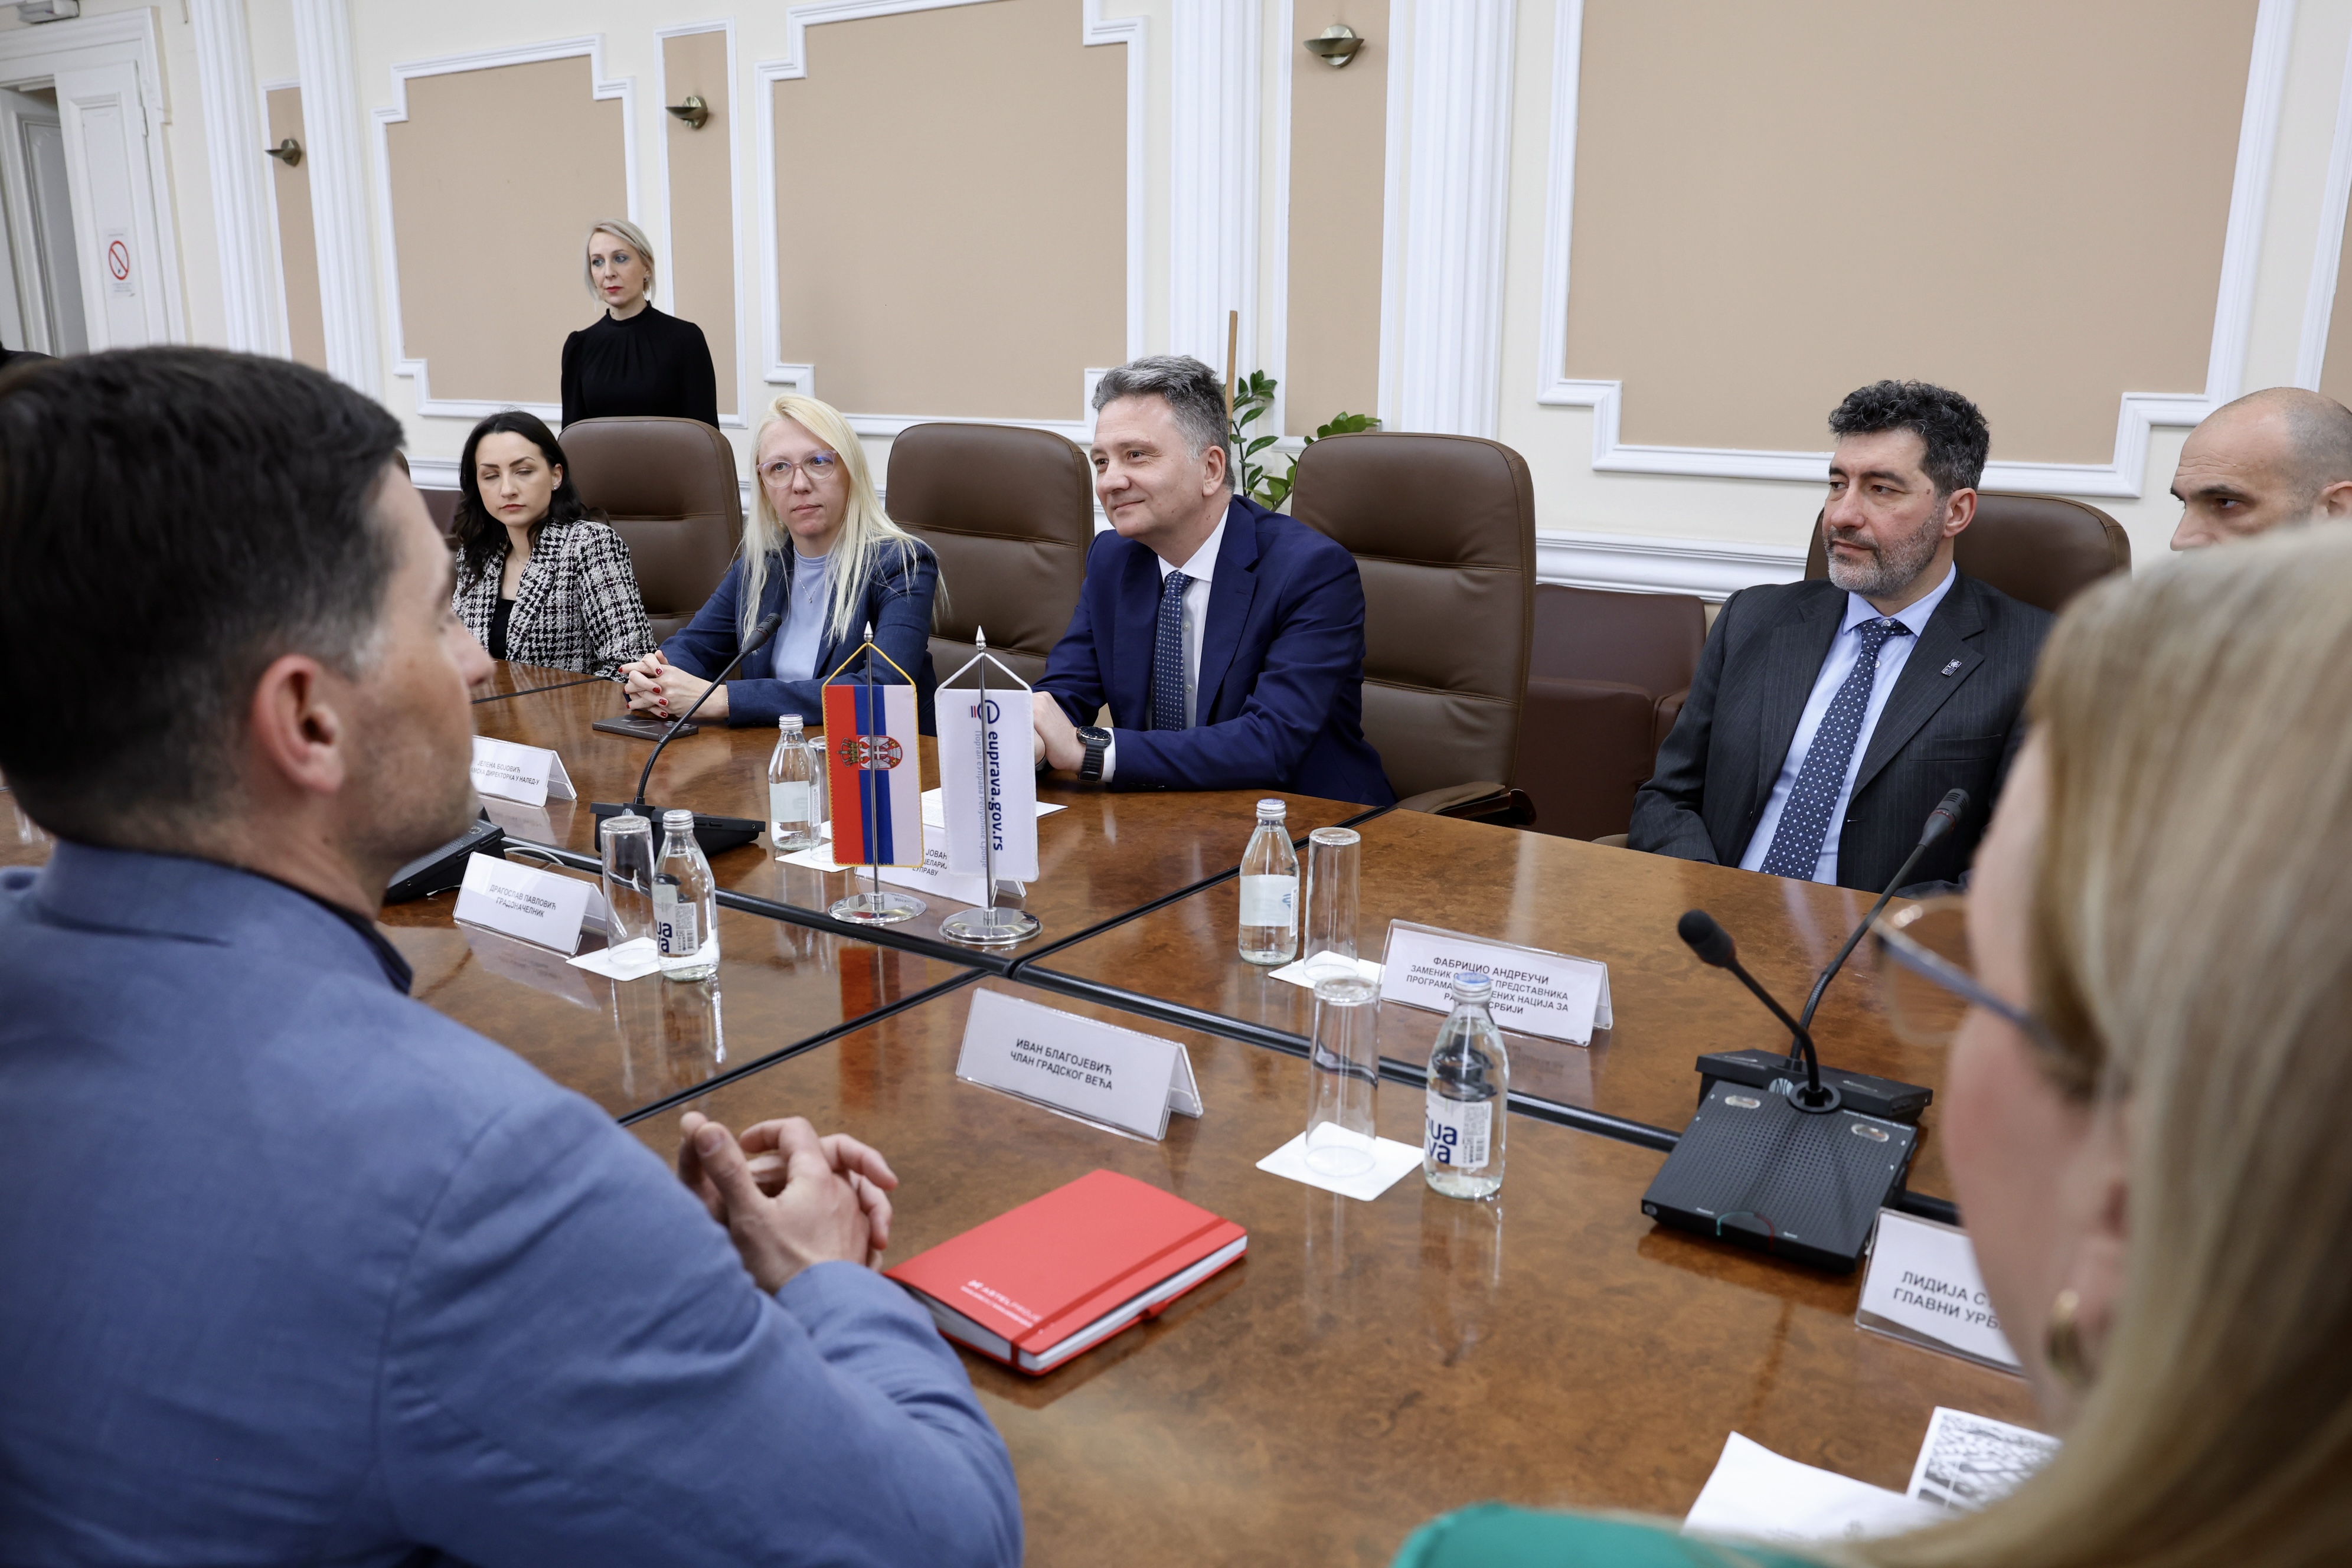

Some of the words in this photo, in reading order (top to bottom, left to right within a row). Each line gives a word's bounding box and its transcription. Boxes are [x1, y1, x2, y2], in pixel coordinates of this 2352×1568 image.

[974, 730, 982, 759] Портал
[471, 767, 485, 775] АМСКА
[485, 770, 515, 780] ДИРЕКТОРКА
[519, 776, 540, 785] НАЛЕД-У
[477, 760, 496, 769] ЈЕЛЕНА
[496, 763, 521, 773] БОЈОВИЋ
[986, 731, 1003, 851] euprava.gov.rs
[925, 848, 947, 860] ЈОВАН
[489, 884, 524, 900] ДРАГОСЛАВ
[524, 894, 556, 910] ПАВЛОВИЋ
[496, 897, 545, 917] ГРАДОНАЧЕЛНИК
[655, 919, 672, 938] ua
[1410, 965, 1452, 979] ЗАМЕНИК
[1495, 980, 1568, 1001] ПРЕДСТАВНИКА
[1433, 956, 1490, 974] ФАБРИЦИО
[1492, 967, 1549, 985] АНДРЕУЧИ
[1406, 975, 1453, 990] ПРОГРАМА
[1491, 990, 1516, 1002] ЕНИХ
[1517, 995, 1554, 1010] НАЦИЈА
[1556, 1002, 1569, 1012] ЗА
[1488, 1001, 1524, 1014] СРБИЈИ
[1010, 1050, 1035, 1066] ЧЛАН
[1036, 1059, 1084, 1080] ГРАДСКОГ
[1085, 1074, 1112, 1090] ВЕЋА
[1016, 1038, 1043, 1054] ИВАН
[1045, 1047, 1112, 1076] БЛАГОЈЕВИЋ
[1429, 1119, 1458, 1146] ua
[1902, 1271, 1968, 1301] ЛИДИЈА
[1893, 1287, 1961, 1319] ГЛАВНИ
[1965, 1308, 2001, 1329] УРБ
